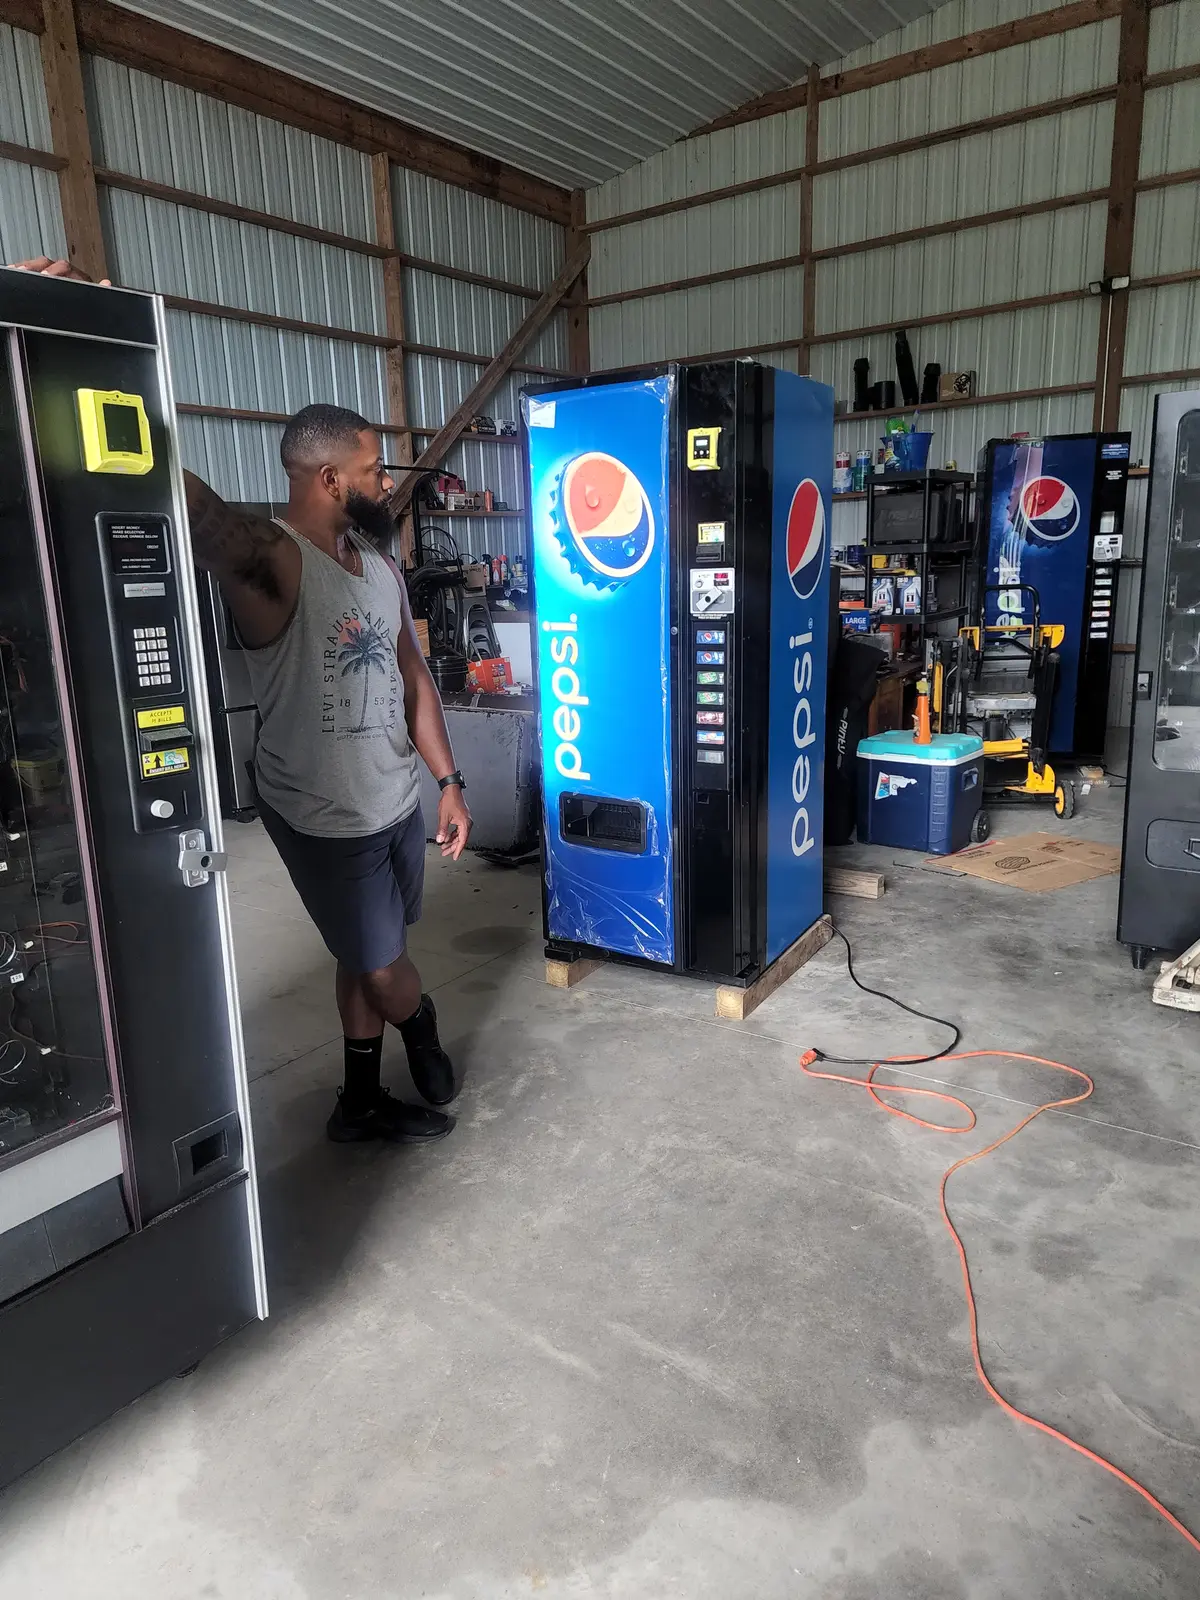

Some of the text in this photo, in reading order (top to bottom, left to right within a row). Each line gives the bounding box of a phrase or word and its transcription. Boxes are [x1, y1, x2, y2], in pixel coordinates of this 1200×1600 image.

[323, 608, 359, 683] STRAUSS
[365, 612, 390, 639] AND
[150, 710, 172, 718] ACCEPTS
[322, 693, 335, 734] LEVI
[340, 697, 385, 707] 18 53
[542, 616, 590, 781] pepsi
[789, 632, 815, 856] pepsi
